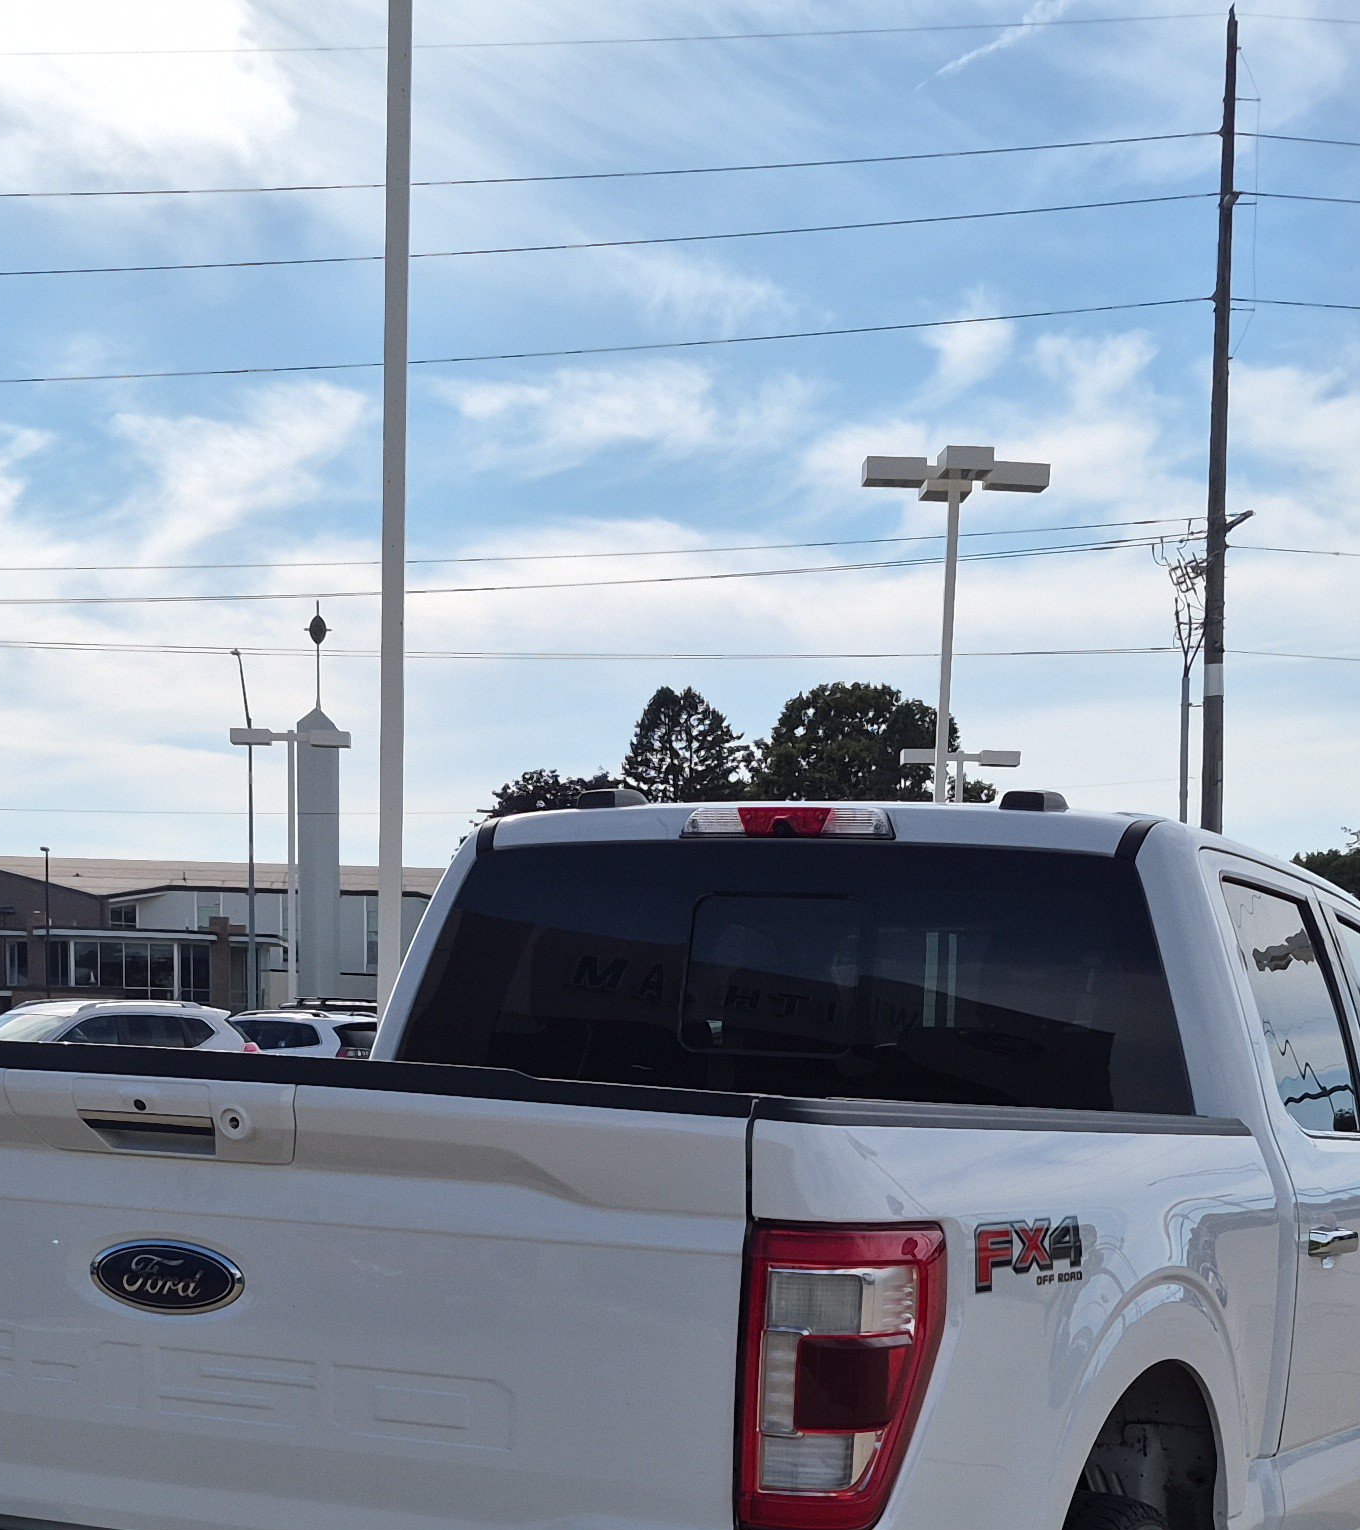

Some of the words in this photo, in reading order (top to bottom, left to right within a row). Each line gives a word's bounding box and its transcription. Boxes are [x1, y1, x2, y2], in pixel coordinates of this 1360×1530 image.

[122, 1254, 205, 1298] Ford
[974, 1215, 1083, 1294] FX4
[1036, 1274, 1055, 1286] OFF
[1058, 1271, 1083, 1283] ROAD
